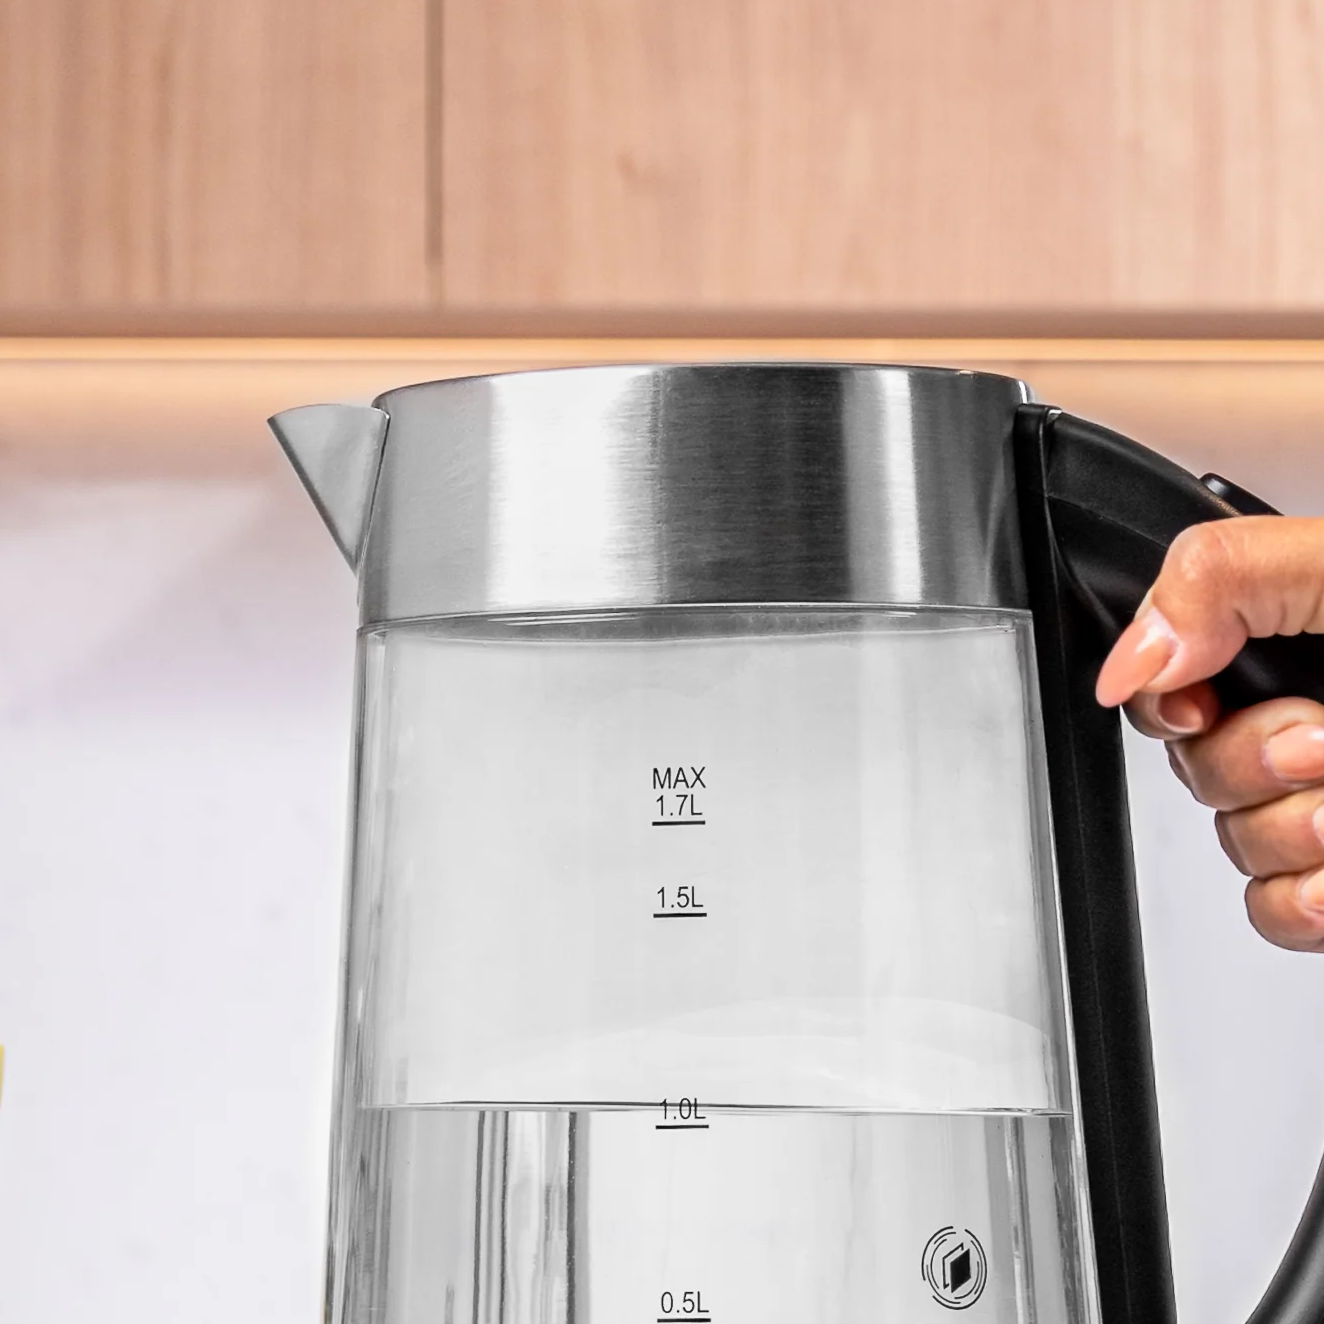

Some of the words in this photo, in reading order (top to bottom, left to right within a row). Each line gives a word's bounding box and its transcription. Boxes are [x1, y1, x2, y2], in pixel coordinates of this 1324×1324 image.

[652, 766, 706, 789] MAX
[656, 793, 703, 817] 1.7L
[657, 885, 704, 909] 1.5L
[659, 1097, 706, 1121] 1.0L
[661, 1290, 710, 1314] 0.5L
